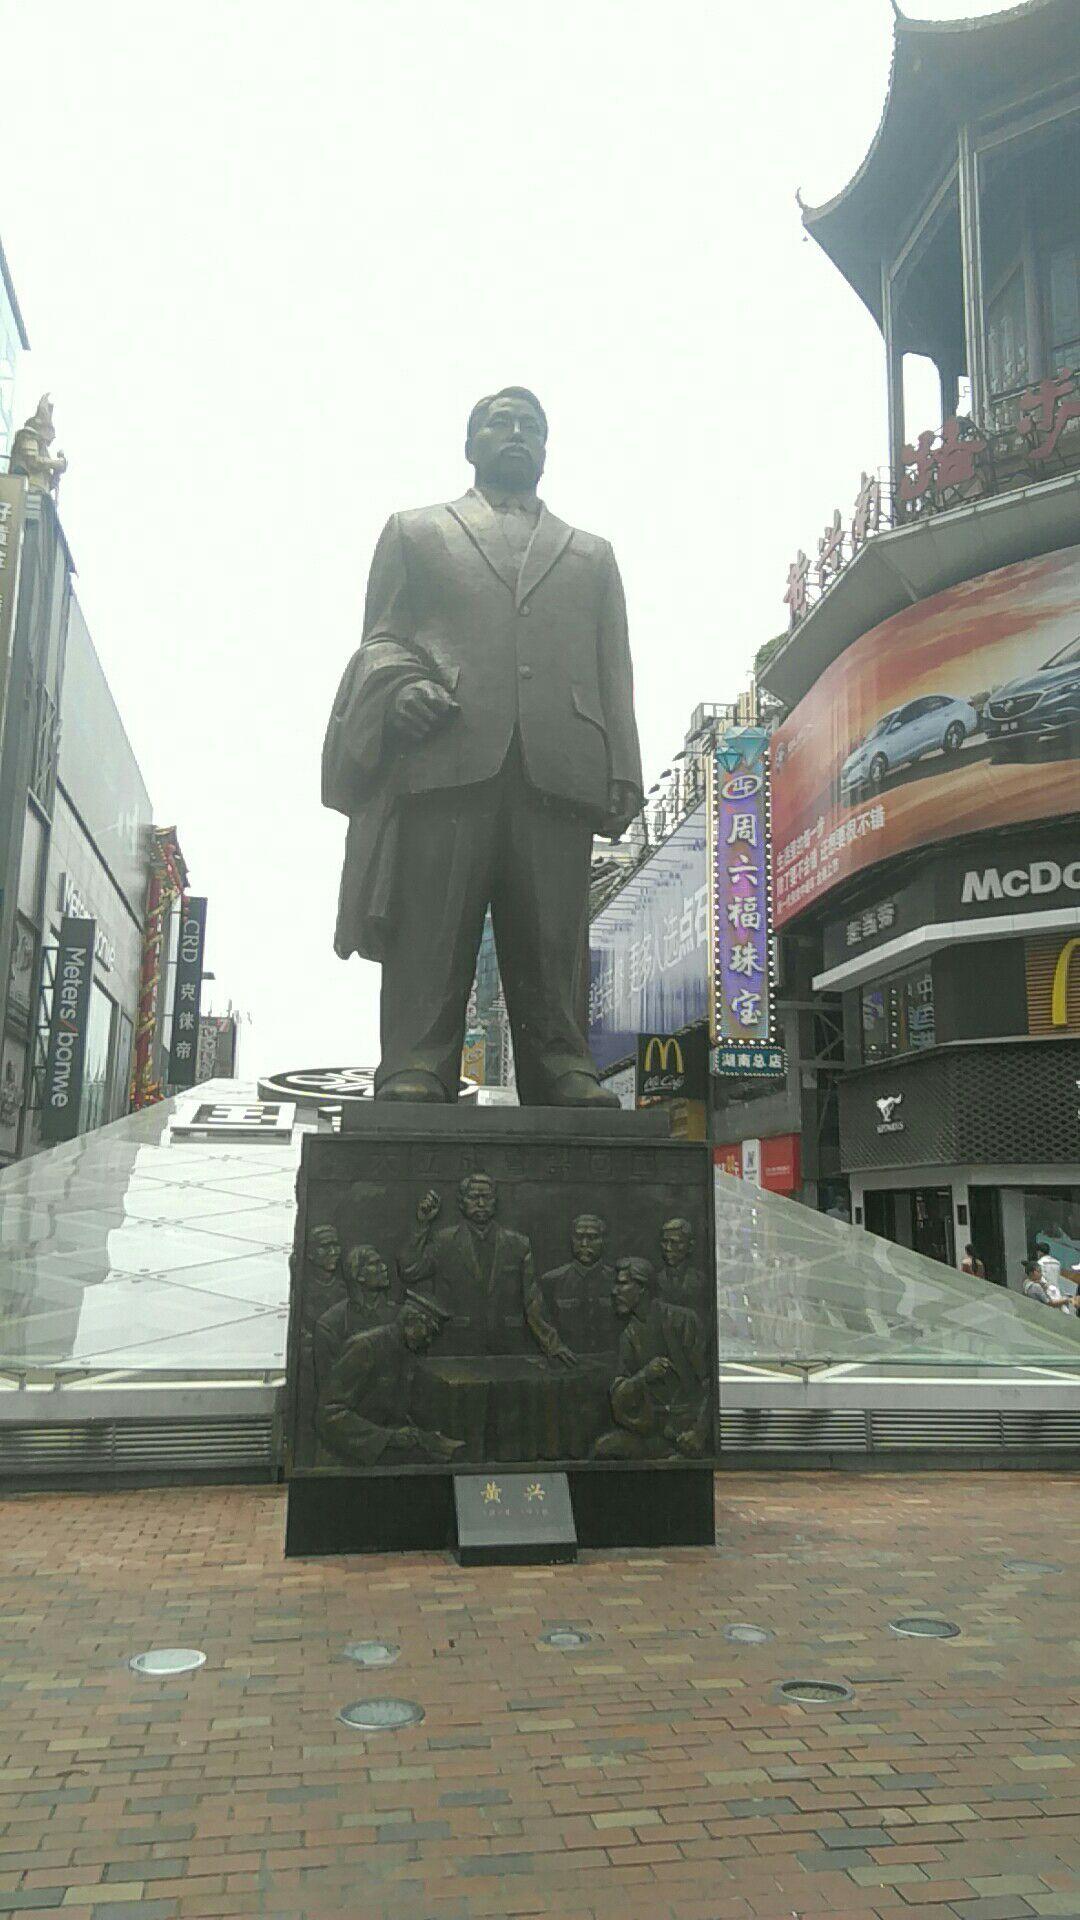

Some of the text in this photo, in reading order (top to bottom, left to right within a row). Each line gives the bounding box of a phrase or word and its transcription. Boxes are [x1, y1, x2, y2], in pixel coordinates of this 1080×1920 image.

[181, 919, 200, 963] CRD
[727, 813, 764, 1026] 周六福珠宝
[721, 1053, 782, 1069] 湖南总店
